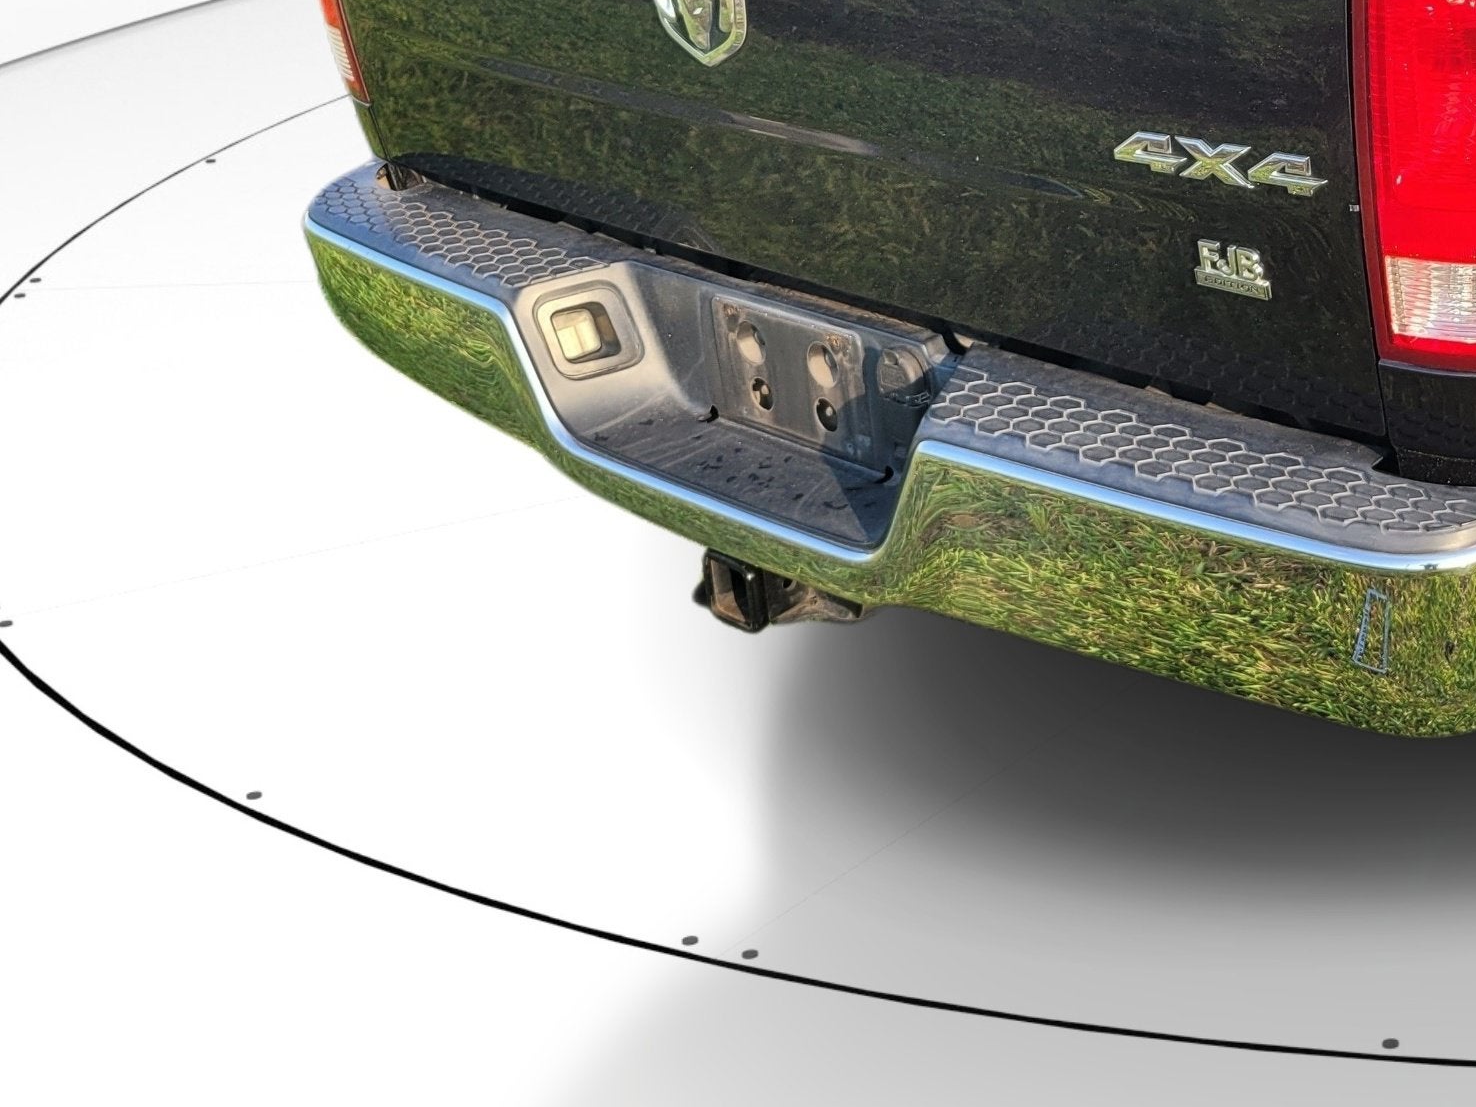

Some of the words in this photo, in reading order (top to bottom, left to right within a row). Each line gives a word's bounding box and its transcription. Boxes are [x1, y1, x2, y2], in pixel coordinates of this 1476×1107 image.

[1113, 131, 1328, 197] 4X4
[1197, 238, 1264, 282] FJB
[1204, 275, 1260, 294] EDITION
